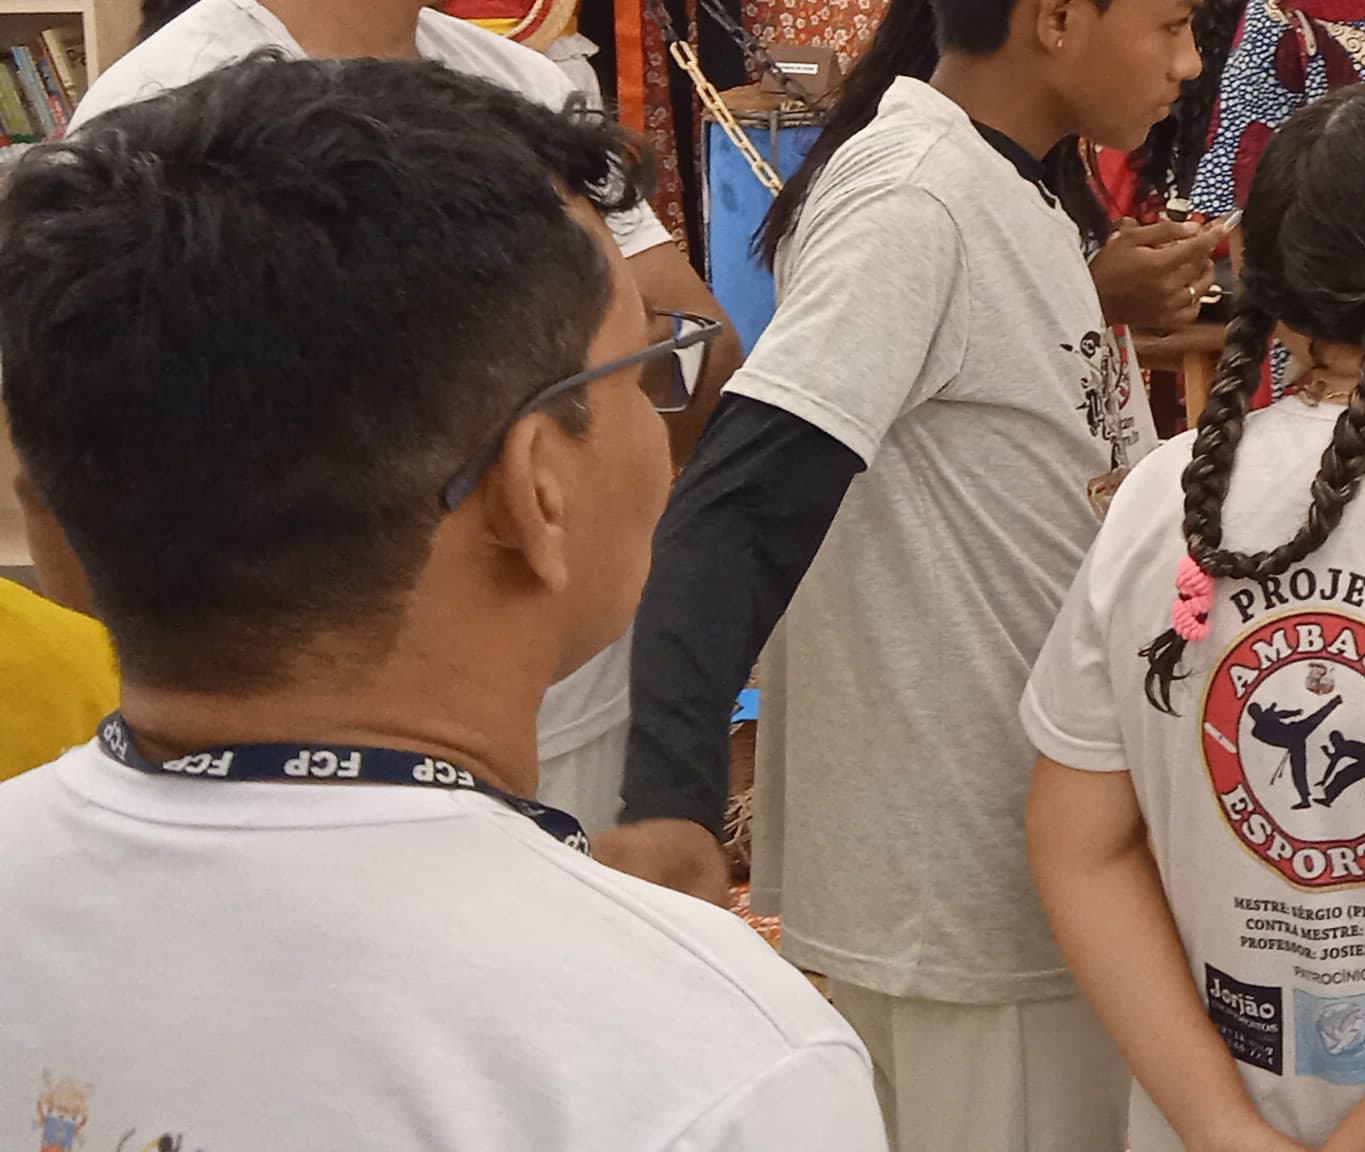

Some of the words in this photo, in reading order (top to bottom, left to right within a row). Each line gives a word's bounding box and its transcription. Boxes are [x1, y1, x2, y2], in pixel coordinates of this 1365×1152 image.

[162, 749, 236, 777] FCP
[284, 749, 363, 778] FCP
[411, 757, 476, 788] FCP
[1245, 918, 1300, 936] CONTRA
[1301, 925, 1364, 941] MESTRE:
